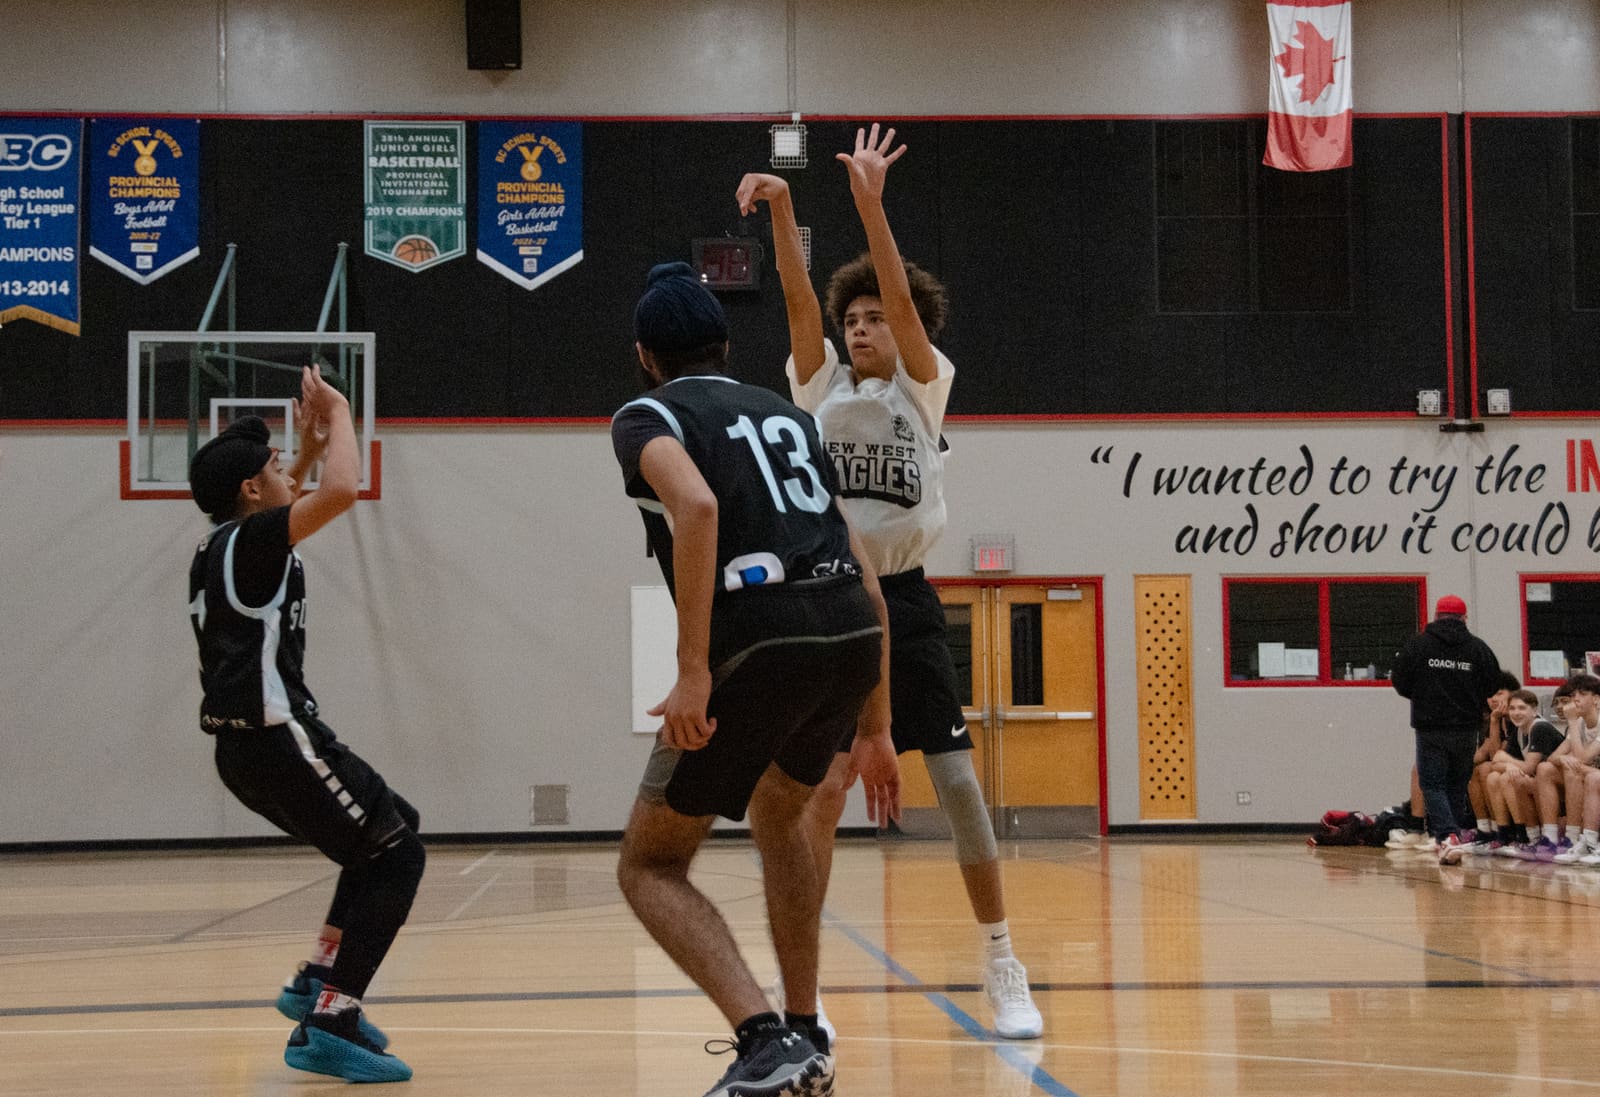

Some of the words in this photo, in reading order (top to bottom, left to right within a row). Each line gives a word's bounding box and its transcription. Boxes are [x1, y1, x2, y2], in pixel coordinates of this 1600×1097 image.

[115, 126, 152, 146] SCHOOL
[154, 129, 183, 158] SPORTS
[408, 135, 450, 143] ANNUAL
[374, 144, 418, 152] JUNIOR
[422, 144, 456, 152] GIRLS
[502, 132, 537, 152] SCHOOL
[539, 135, 567, 164] SPORTS
[368, 156, 461, 168] BASKETBALL
[109, 176, 181, 187] PROVINCIAL
[497, 182, 565, 193] PROVINCIAL
[19, 186, 64, 199] School
[109, 187, 181, 198] CHAMPIONS
[382, 188, 448, 196] TOURNAMENT
[496, 193, 565, 204] CHAMPIONS
[26, 202, 75, 217] League
[113, 202, 141, 217] Boys
[366, 206, 393, 216] 2019
[395, 206, 464, 216] CHAMPIONS
[497, 209, 523, 226] Girls
[524, 205, 566, 219] AAAA
[3, 216, 30, 229] Tier
[33, 217, 41, 229] 1
[124, 214, 167, 230] Football
[505, 220, 558, 236] Basketball
[0, 280, 70, 296] 13-2014
[824, 442, 857, 454] EW
[865, 444, 916, 459] WEST
[726, 414, 831, 514] 13
[833, 454, 922, 510] AGLES
[1153, 444, 1314, 496] wanted
[1329, 456, 1371, 495] to
[1388, 456, 1458, 513] try
[1475, 444, 1546, 495] the
[1175, 503, 1259, 556] and
[1269, 502, 1388, 558] show
[1401, 512, 1438, 554] it
[1451, 501, 1570, 556] could
[979, 547, 1005, 568] EXIT
[1428, 658, 1456, 669] COACH
